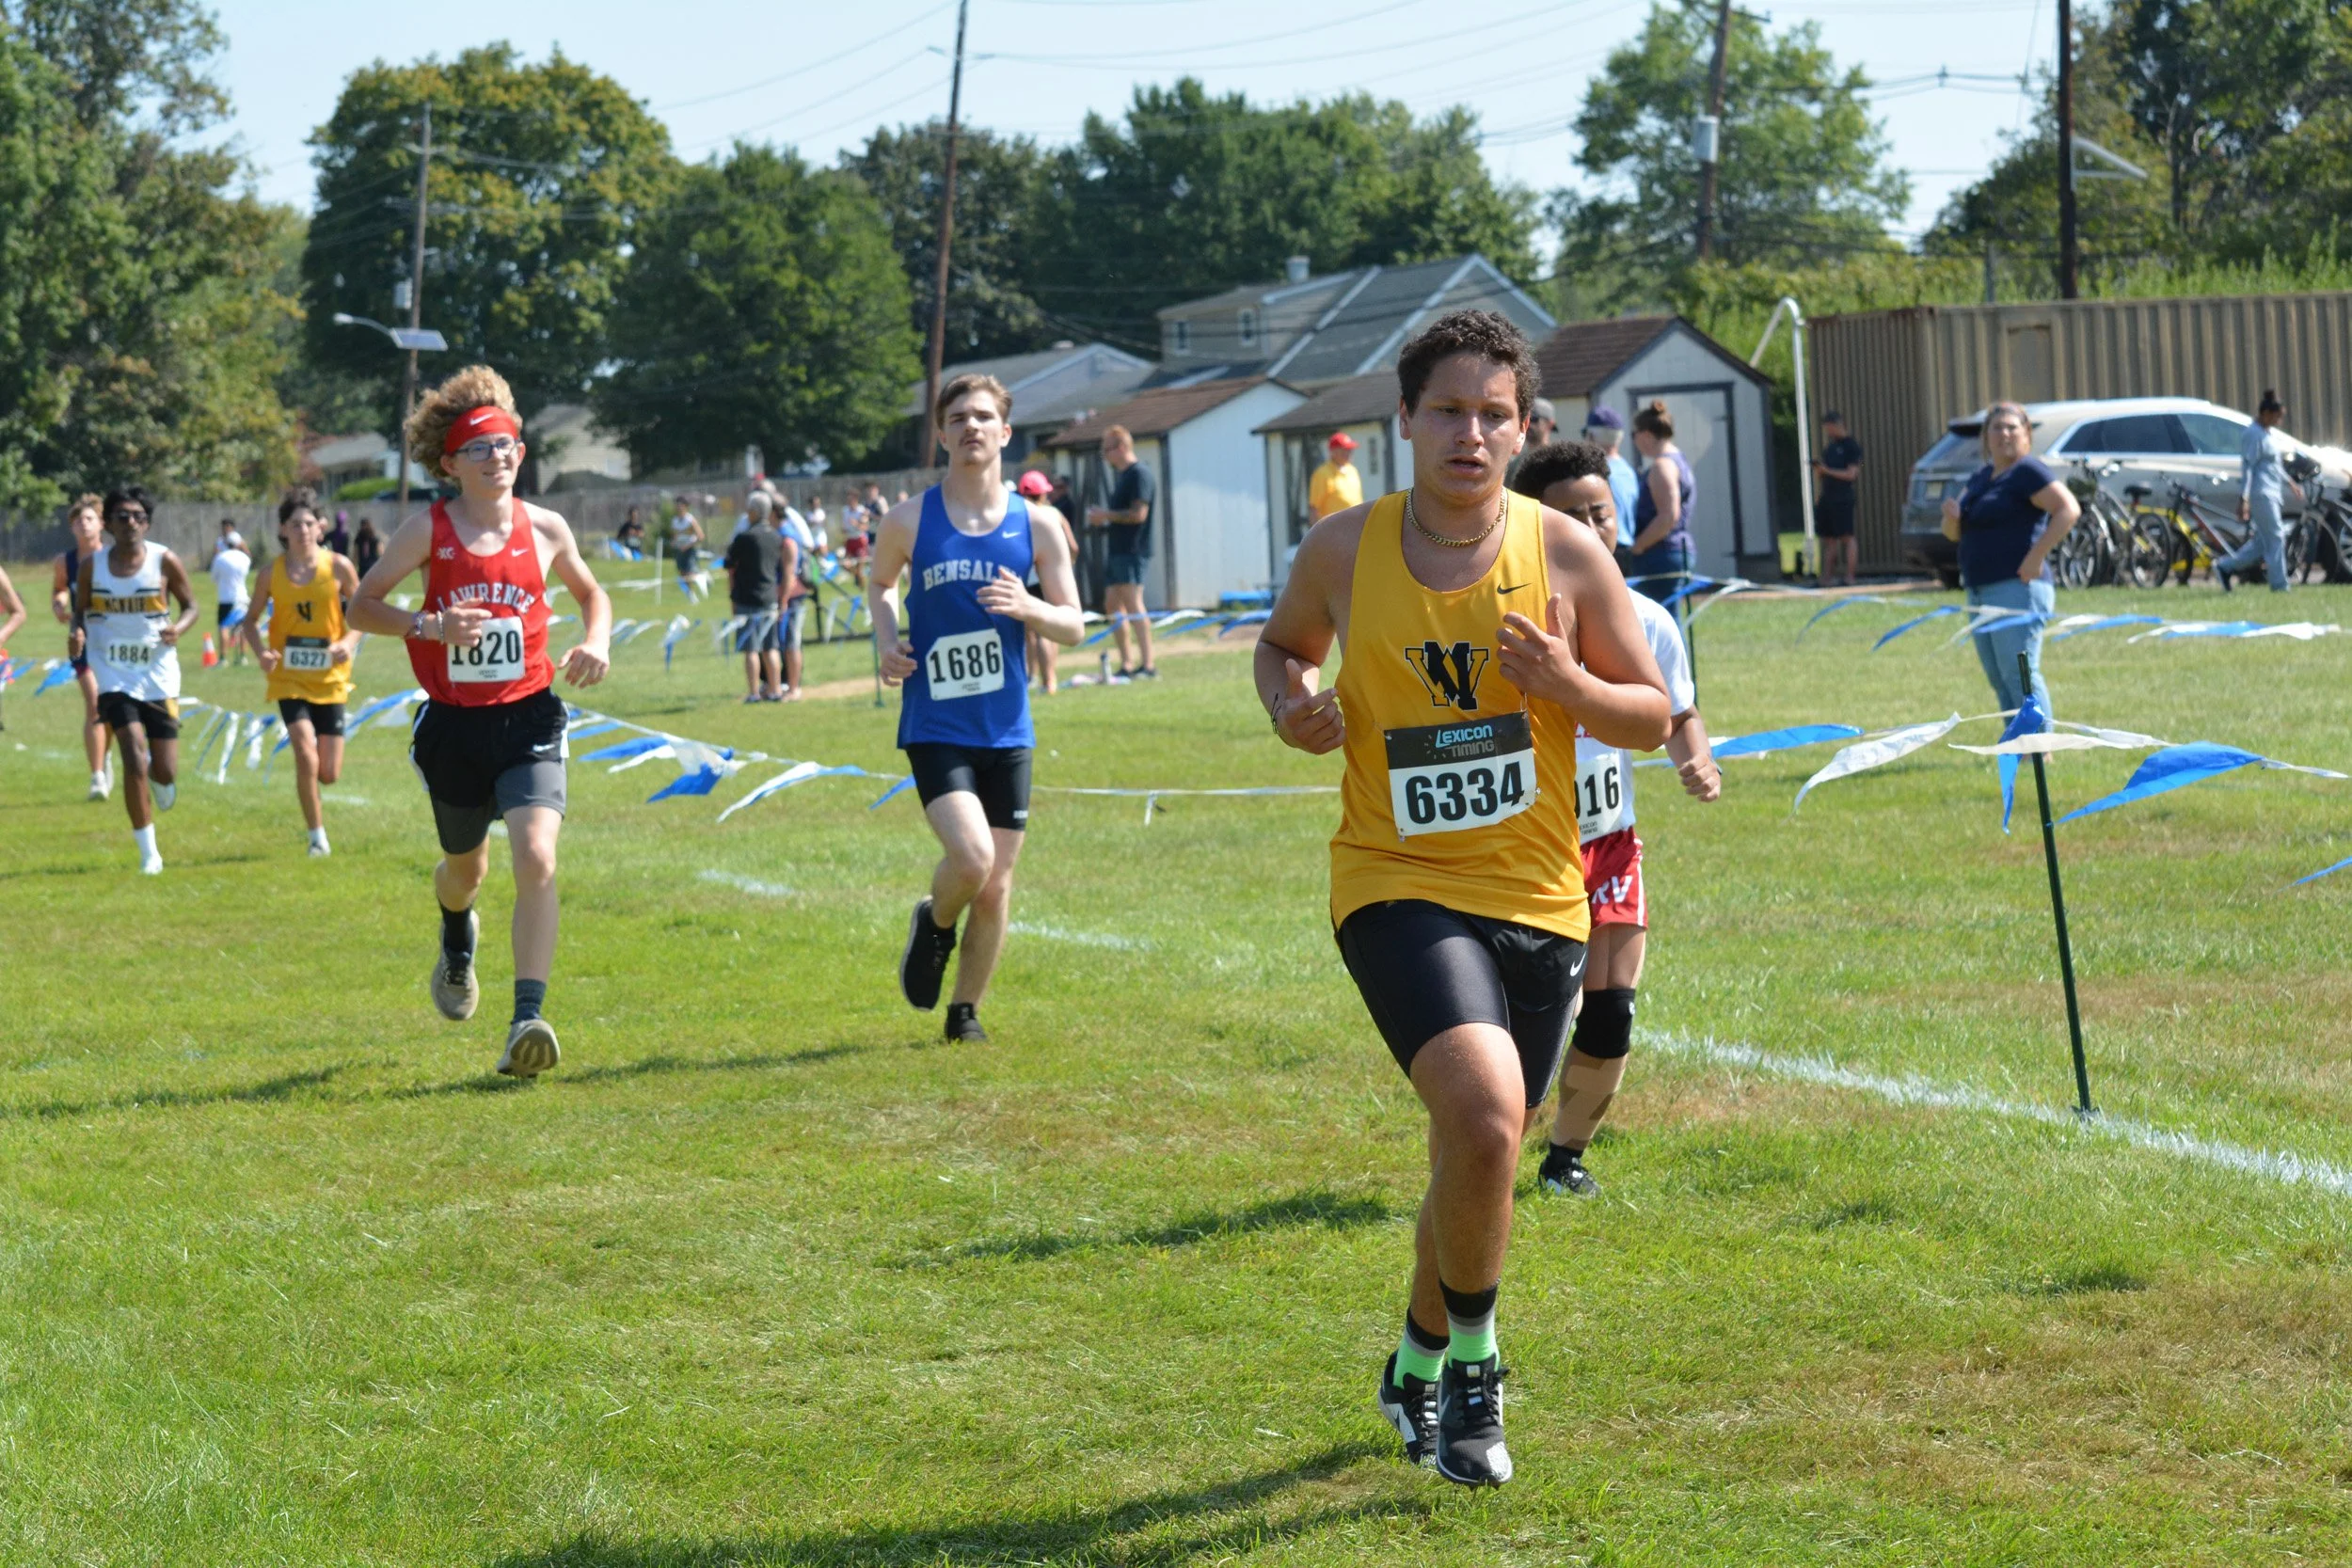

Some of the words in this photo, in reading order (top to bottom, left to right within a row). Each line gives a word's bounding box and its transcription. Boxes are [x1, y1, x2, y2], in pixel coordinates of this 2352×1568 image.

[922, 559, 1023, 592] BENSAL
[437, 581, 535, 614] LAWRENCE
[109, 643, 150, 664] 1884
[290, 651, 326, 667] 6327
[452, 630, 522, 667] 1820
[930, 641, 1001, 684] 1686
[1435, 724, 1493, 749] LEXICON
[1444, 738, 1495, 758] TIMING
[1405, 761, 1525, 825] 6334
